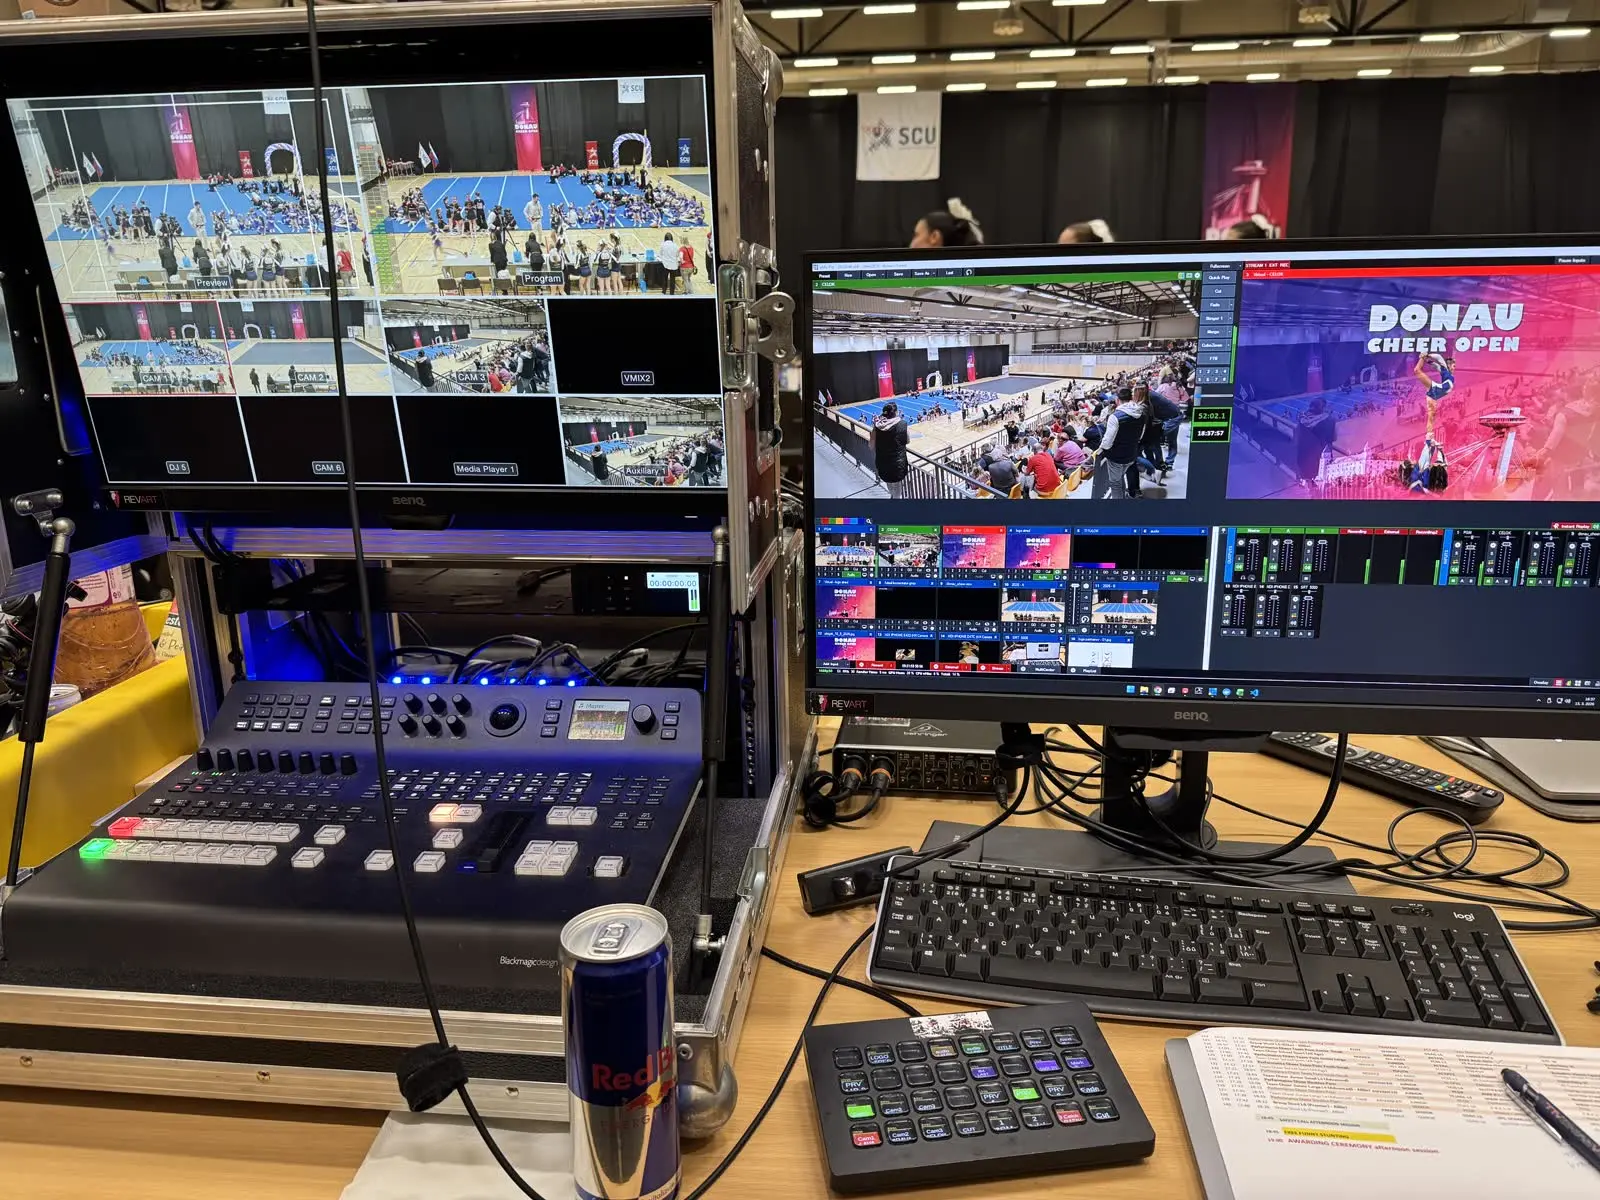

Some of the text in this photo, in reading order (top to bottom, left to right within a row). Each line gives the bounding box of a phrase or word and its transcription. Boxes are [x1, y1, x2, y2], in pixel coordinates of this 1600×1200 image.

[899, 126, 936, 146] SCU
[196, 278, 229, 289] Preview
[524, 274, 562, 286] Program
[1368, 303, 1524, 332] DONAU
[1367, 336, 1520, 354] CHEER OPEN
[142, 374, 161, 383] CAM
[298, 373, 324, 382] CAM 2
[457, 373, 486, 382] CAM 3
[623, 374, 651, 383] VMIX2
[1198, 412, 1226, 420] 52:02.1
[169, 463, 187, 472] DJ 5
[315, 464, 342, 472] CAM 6
[456, 465, 480, 473] Media
[483, 465, 509, 476] Player
[626, 467, 659, 477] Auxiliary
[124, 494, 158, 504] REVART
[831, 699, 867, 709] REVART
[1174, 710, 1209, 723] BenQ
[1237, 911, 1268, 919] Backspace
[1453, 911, 1476, 922] logi
[499, 955, 559, 969] Blackmagicdesign
[592, 1053, 654, 1092] Red
[1288, 1138, 1330, 1147] AWARDING
[1330, 1141, 1373, 1150] CEREMONY
